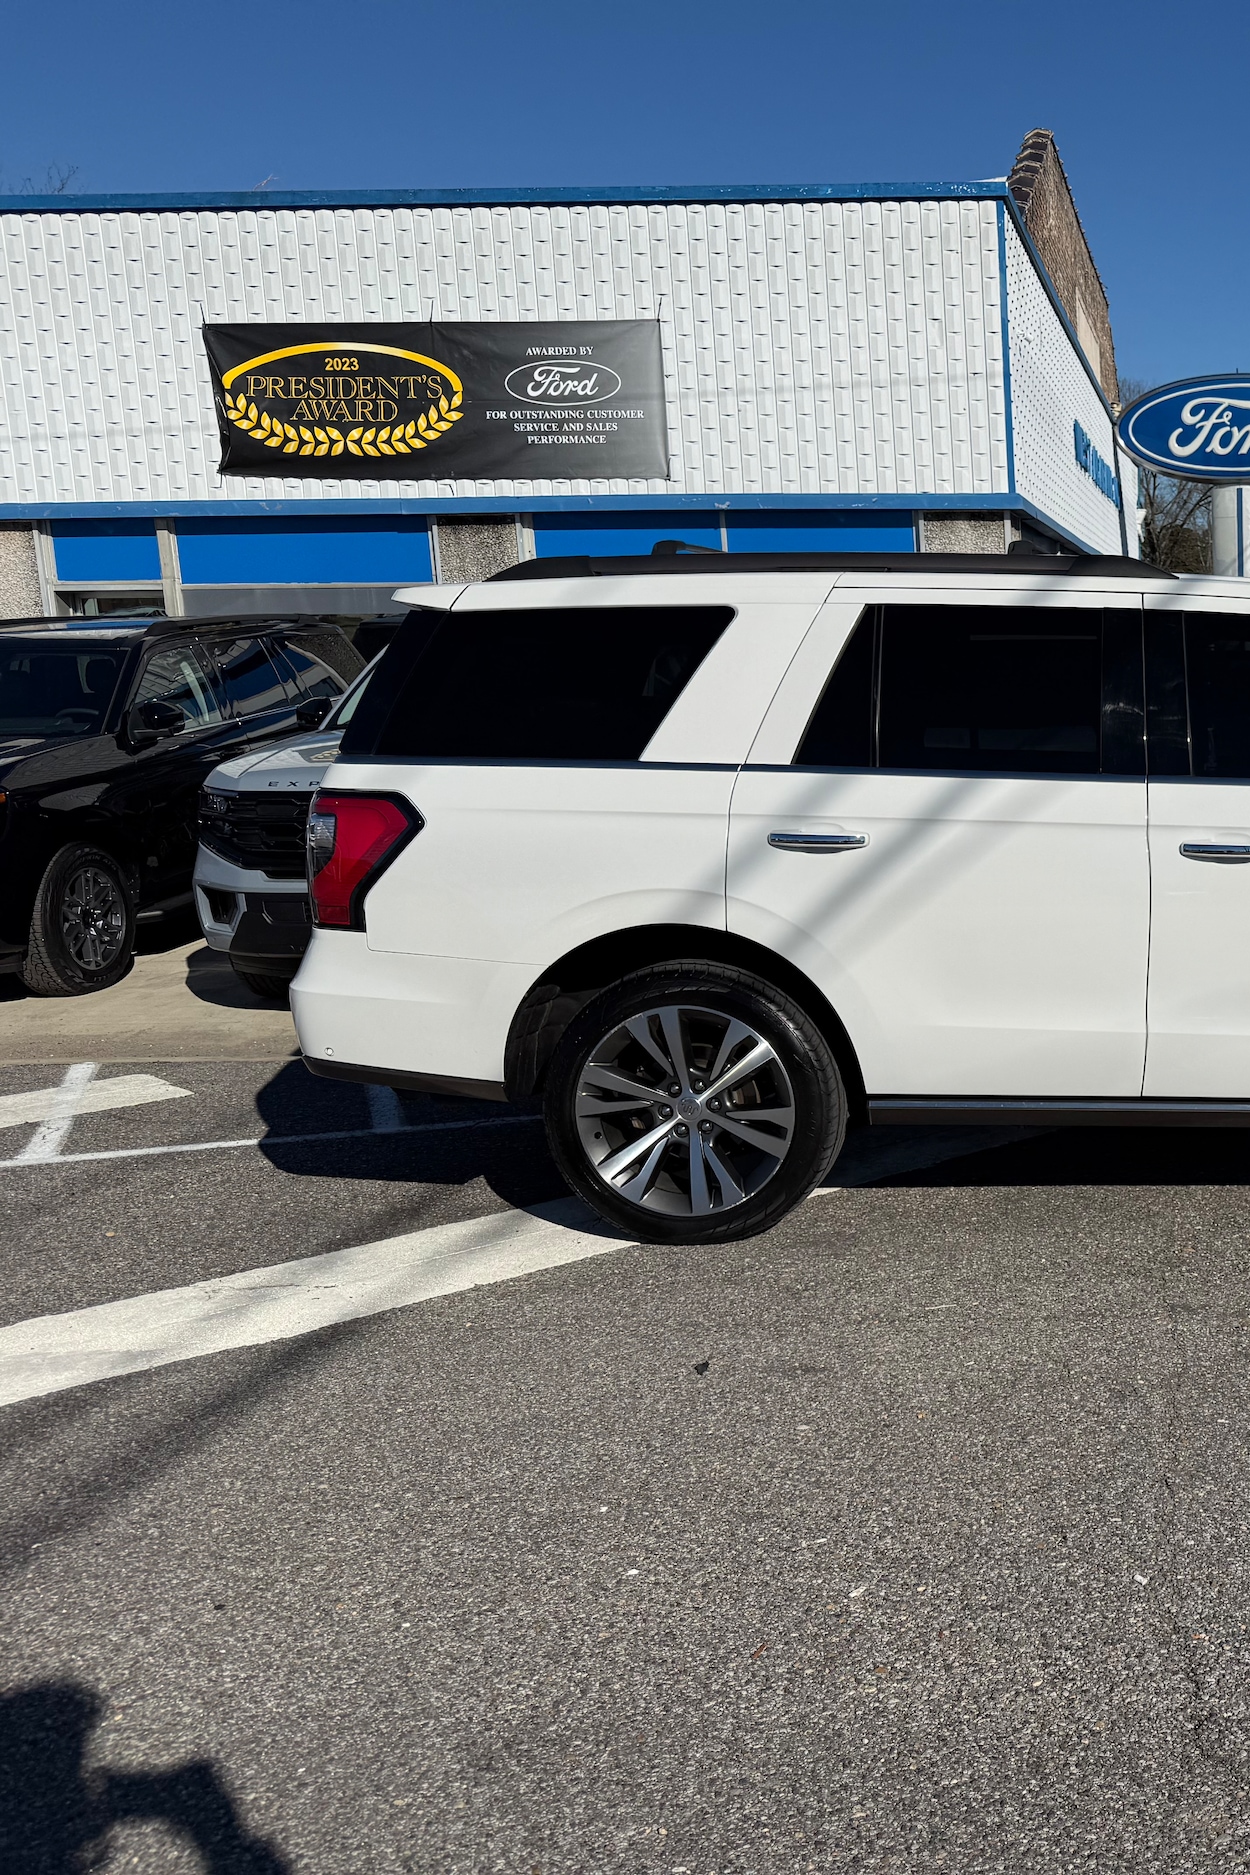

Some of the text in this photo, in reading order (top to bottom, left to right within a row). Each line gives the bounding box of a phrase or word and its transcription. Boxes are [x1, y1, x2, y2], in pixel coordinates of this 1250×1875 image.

[525, 346, 594, 356] AWARDED BY
[325, 357, 360, 371] 2023
[245, 375, 443, 399] PRESIDENT'S
[526, 366, 599, 397] Ford
[290, 399, 398, 422] AWARD
[486, 410, 644, 419] FOR OUTSTANDING CUSTOMER
[513, 422, 618, 432] SERVICE AND SALES
[527, 435, 607, 444] PERFORMANCE
